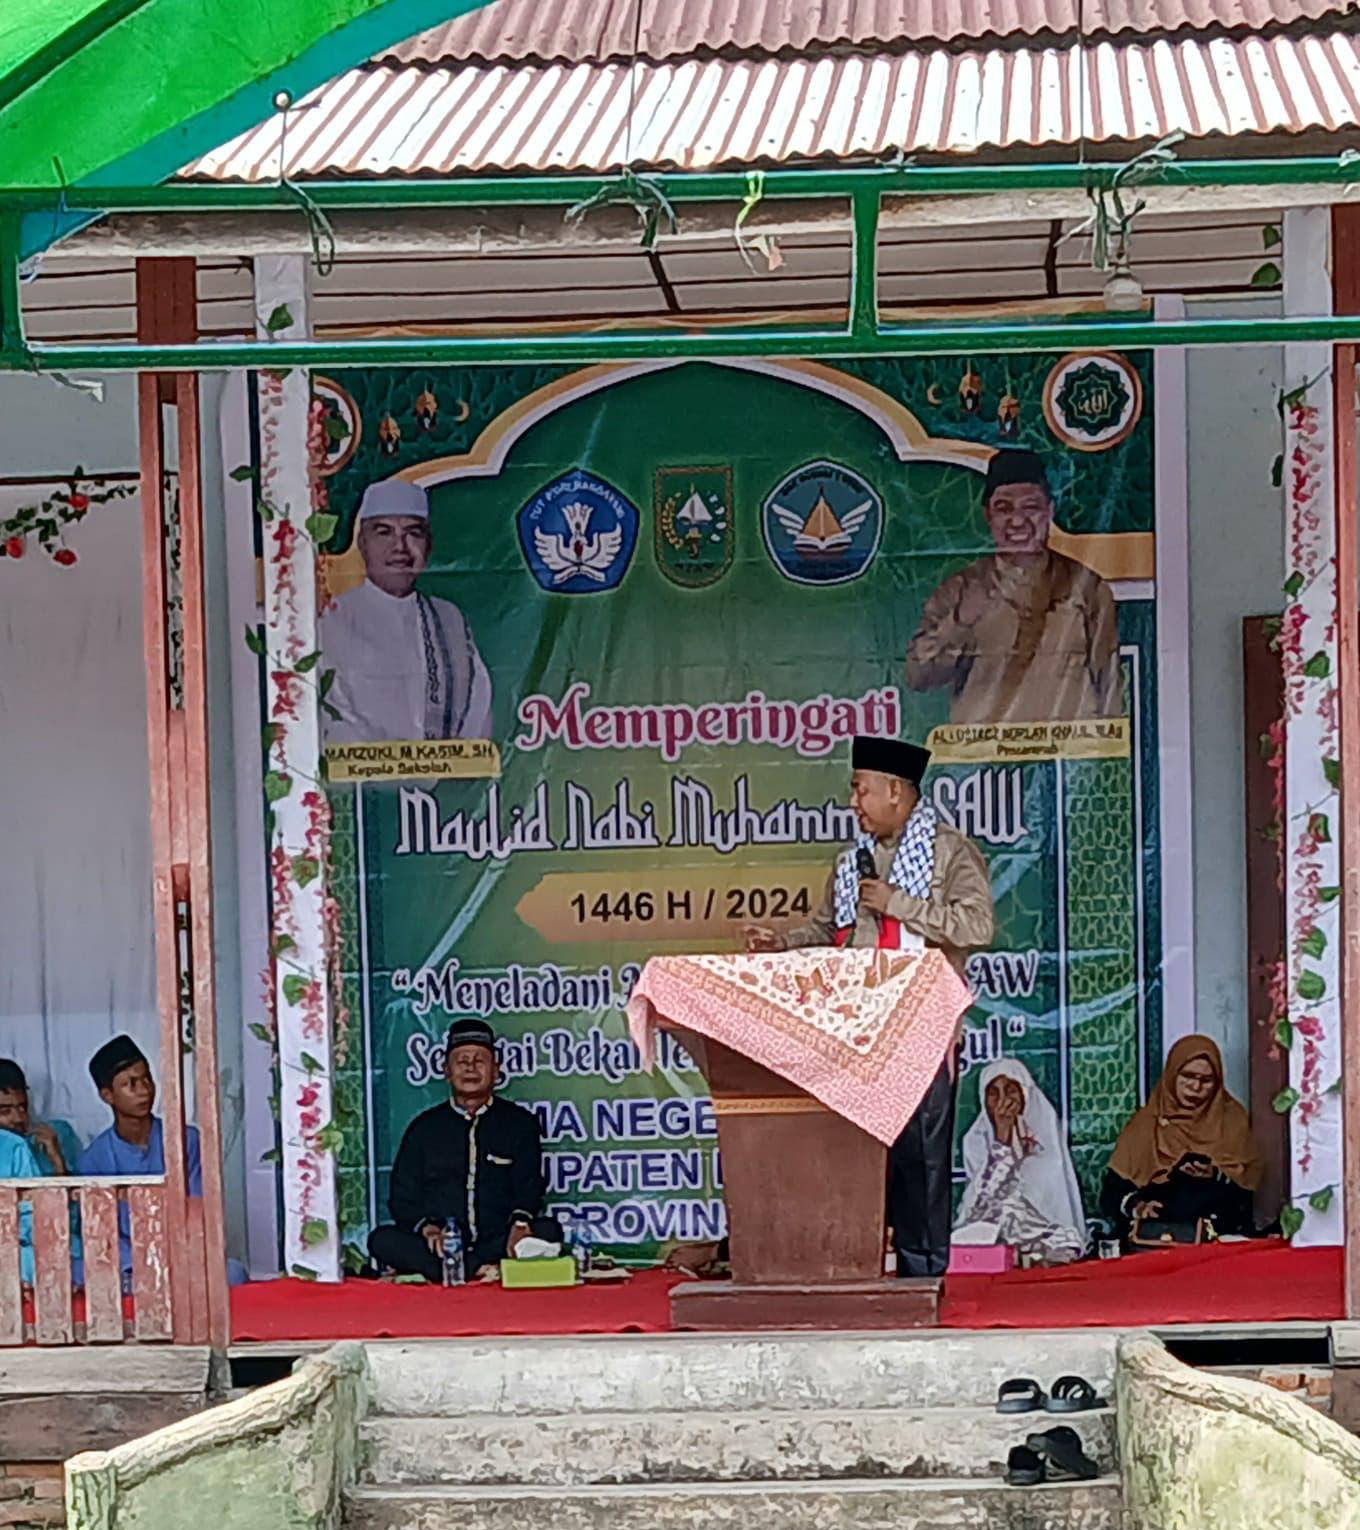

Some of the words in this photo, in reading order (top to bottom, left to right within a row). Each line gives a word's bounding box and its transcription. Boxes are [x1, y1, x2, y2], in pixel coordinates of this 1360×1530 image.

[517, 684, 899, 759] Memperingati
[396, 783, 556, 860] Maulid
[564, 778, 660, 850] Nabi
[668, 774, 860, 853] Muhamm
[933, 767, 1029, 844] SAW
[570, 893, 655, 923] 1446
[667, 891, 692, 920] H
[726, 887, 811, 919] 2024
[414, 960, 611, 1013] Meneladani
[969, 951, 1036, 996] AW
[596, 1101, 718, 1138] NEGE
